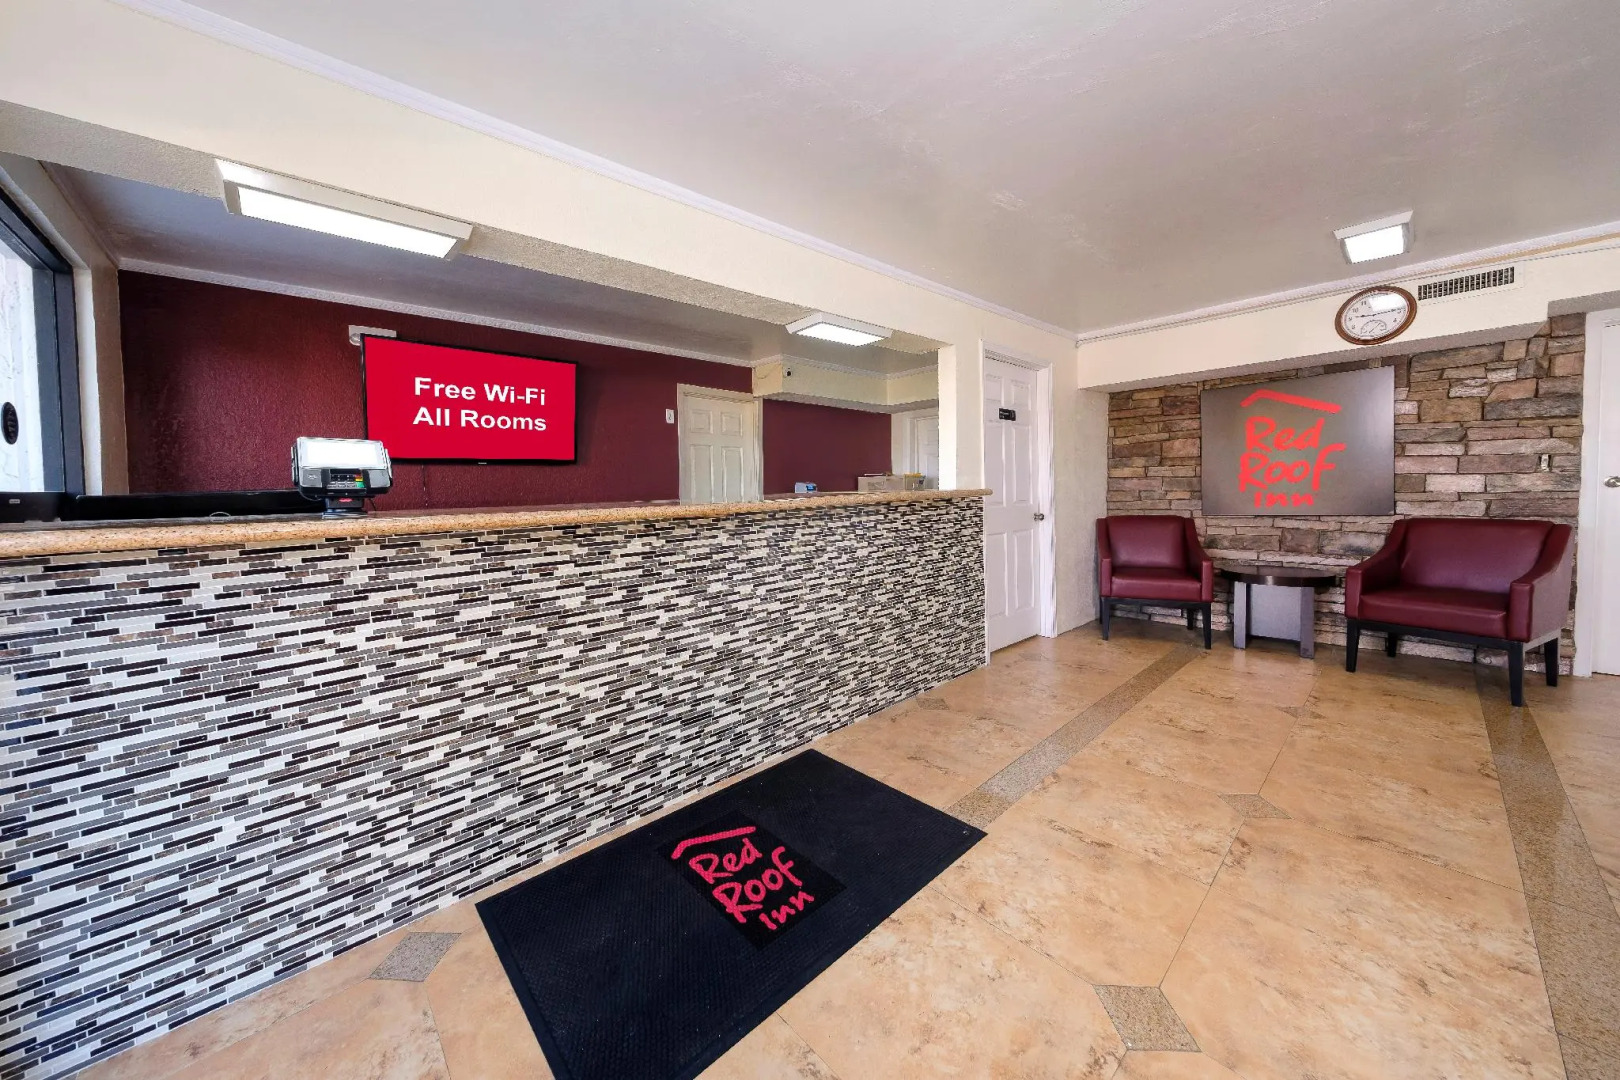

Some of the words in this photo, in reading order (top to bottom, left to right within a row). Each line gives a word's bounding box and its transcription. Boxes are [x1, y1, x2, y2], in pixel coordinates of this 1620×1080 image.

[414, 376, 476, 400] Free
[484, 383, 546, 405] Wi-Fi
[412, 406, 450, 427] All
[460, 409, 547, 431] Rooms
[1245, 416, 1325, 452] Red
[1238, 443, 1347, 492] Roof
[689, 837, 763, 884] Red
[712, 846, 803, 924] Roof
